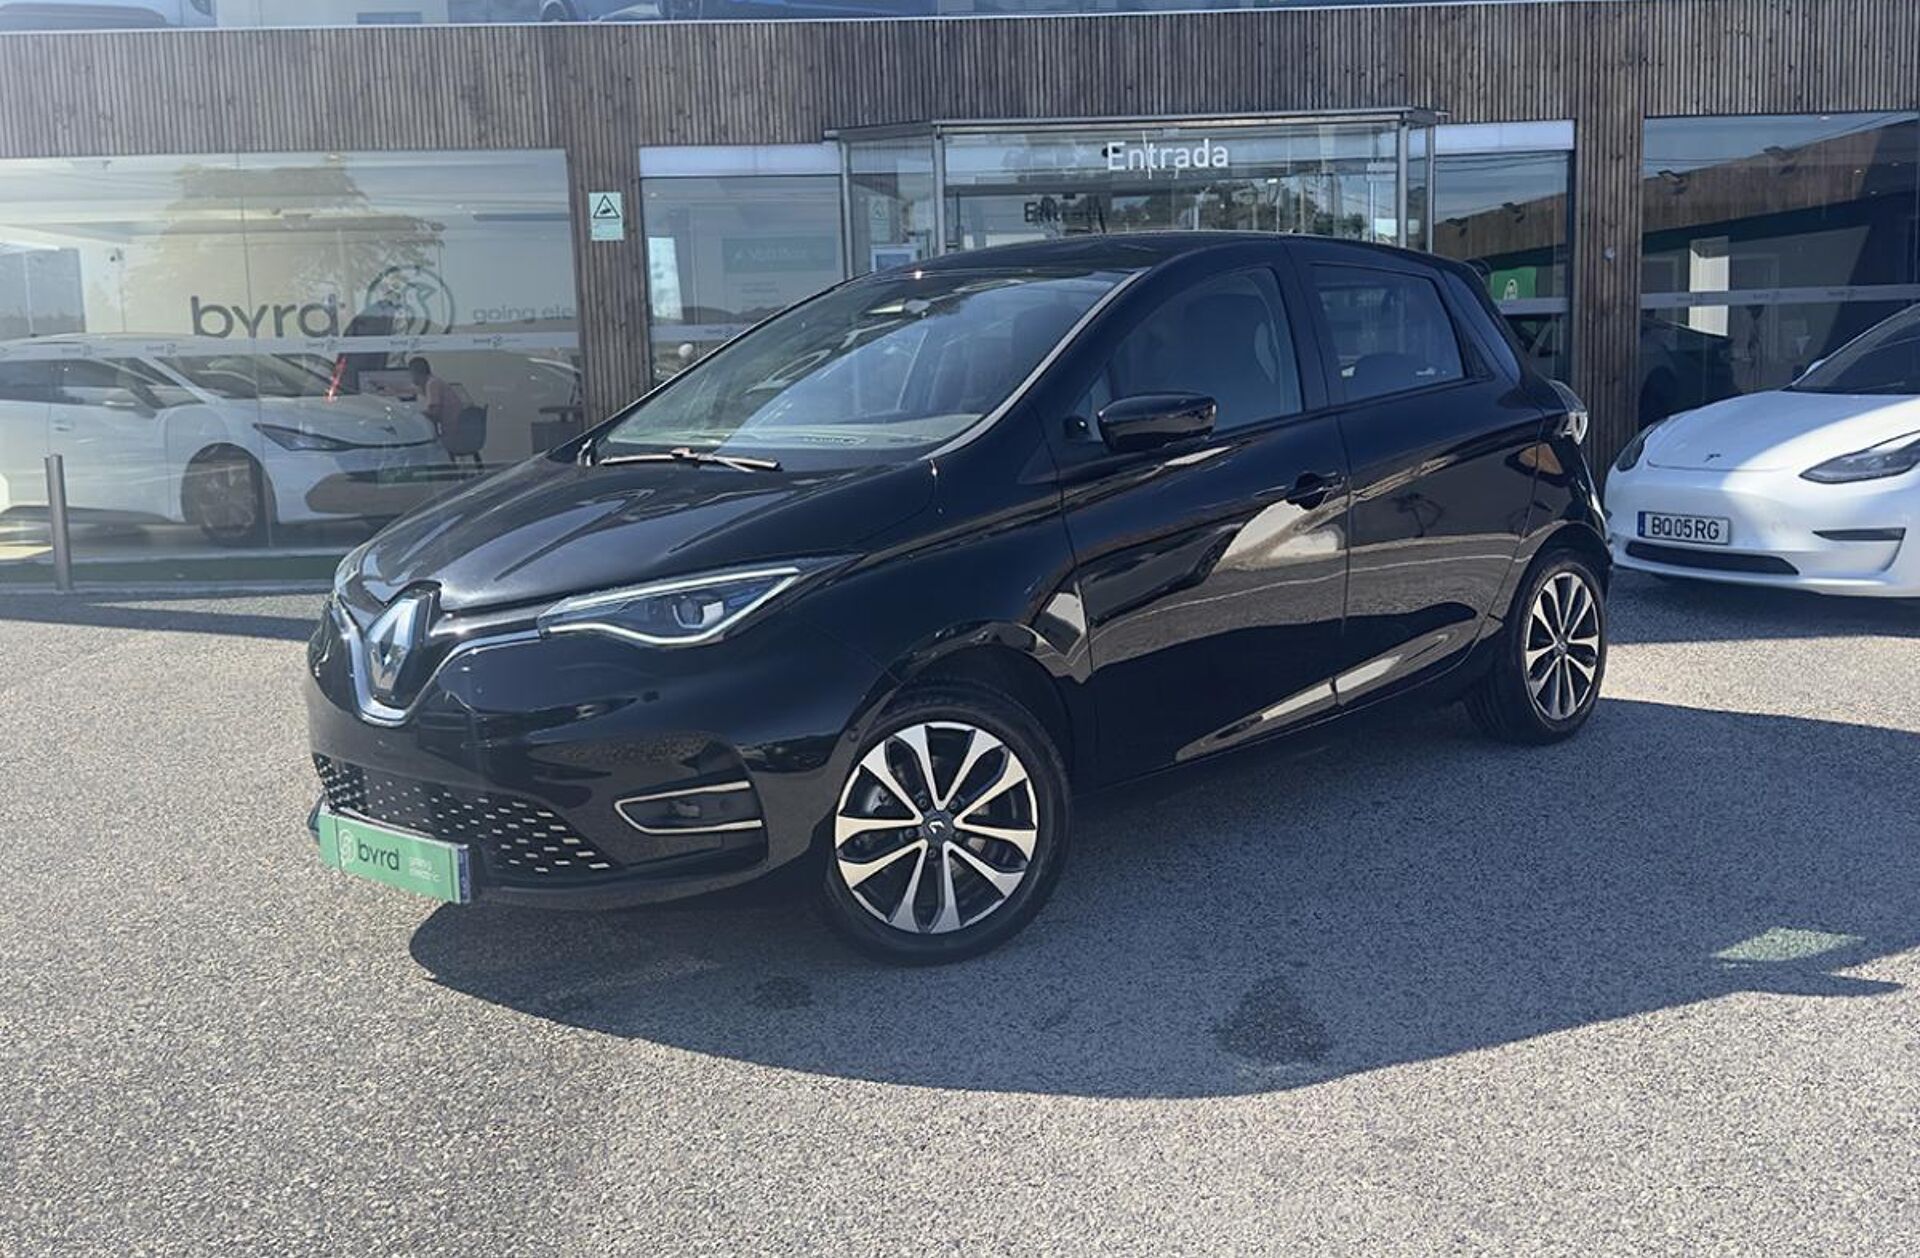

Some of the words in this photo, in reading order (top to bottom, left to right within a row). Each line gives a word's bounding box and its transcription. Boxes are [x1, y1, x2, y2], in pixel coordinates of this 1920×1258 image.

[1107, 138, 1229, 170] Entrada
[190, 293, 339, 338] byrd
[357, 837, 400, 871] byrd
